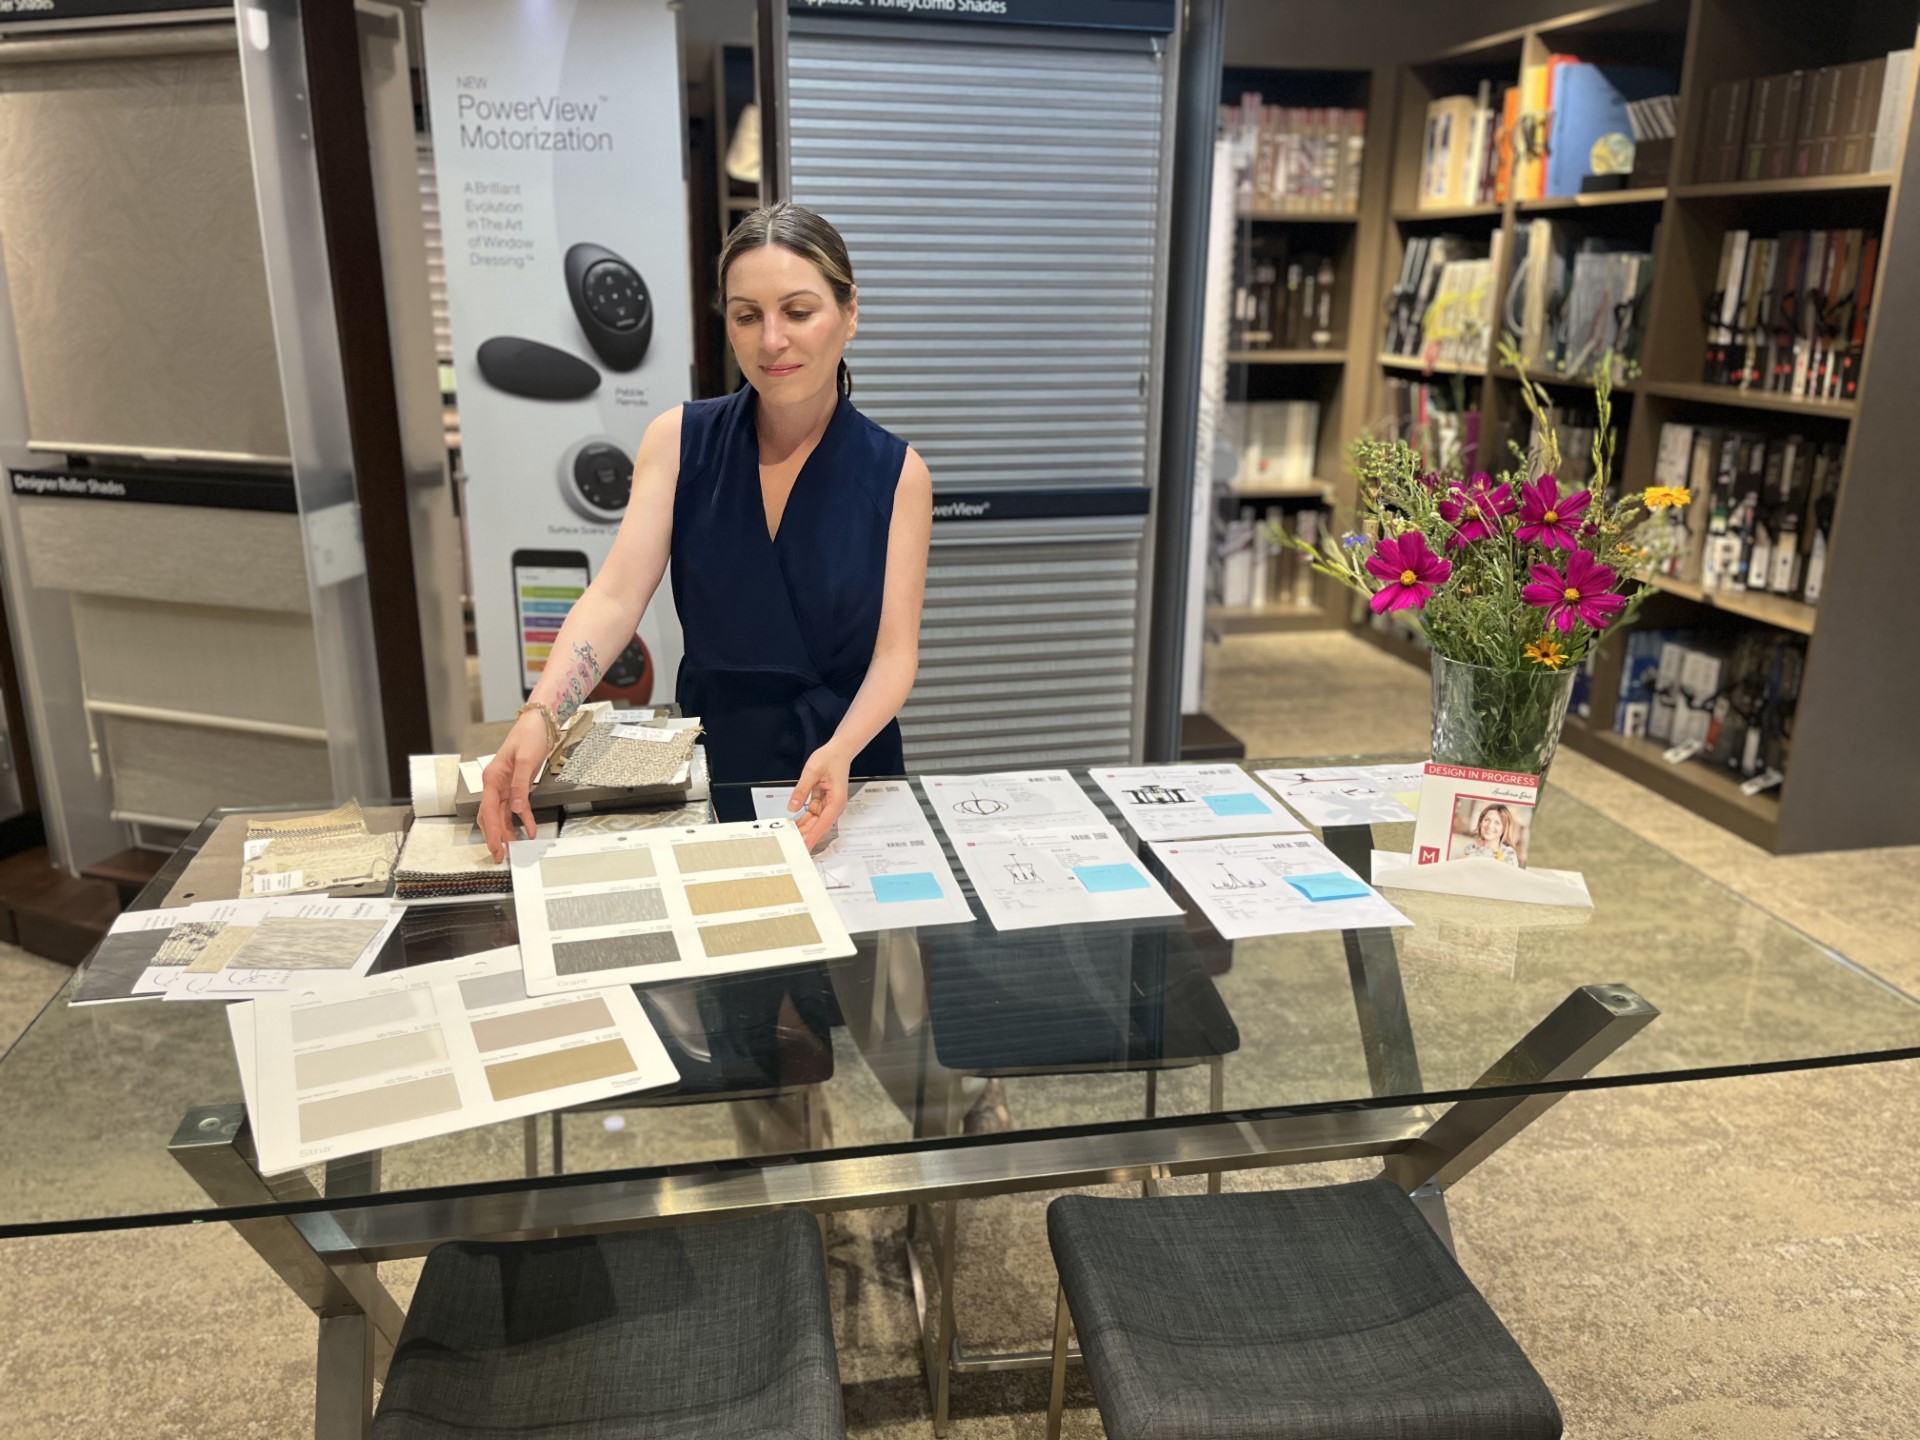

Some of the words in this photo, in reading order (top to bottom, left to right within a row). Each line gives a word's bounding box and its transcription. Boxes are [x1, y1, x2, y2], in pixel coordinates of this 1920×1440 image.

[958, 0, 1007, 13] Shades
[456, 75, 488, 90] NEW
[460, 124, 614, 152] Motorization
[464, 181, 474, 193] A
[474, 181, 521, 195] Brilliant
[465, 199, 523, 213] Evolution
[479, 216, 503, 231] The
[505, 218, 523, 231] Art
[467, 235, 481, 248] of
[482, 235, 535, 249] Window
[14, 474, 57, 493] Designer
[58, 476, 86, 492] Roller
[87, 479, 125, 495] Shades
[1429, 765, 1466, 778] DESIGN
[1468, 770, 1479, 780] IN
[1481, 772, 1535, 786] PROGRESS
[1422, 849, 1436, 863] M
